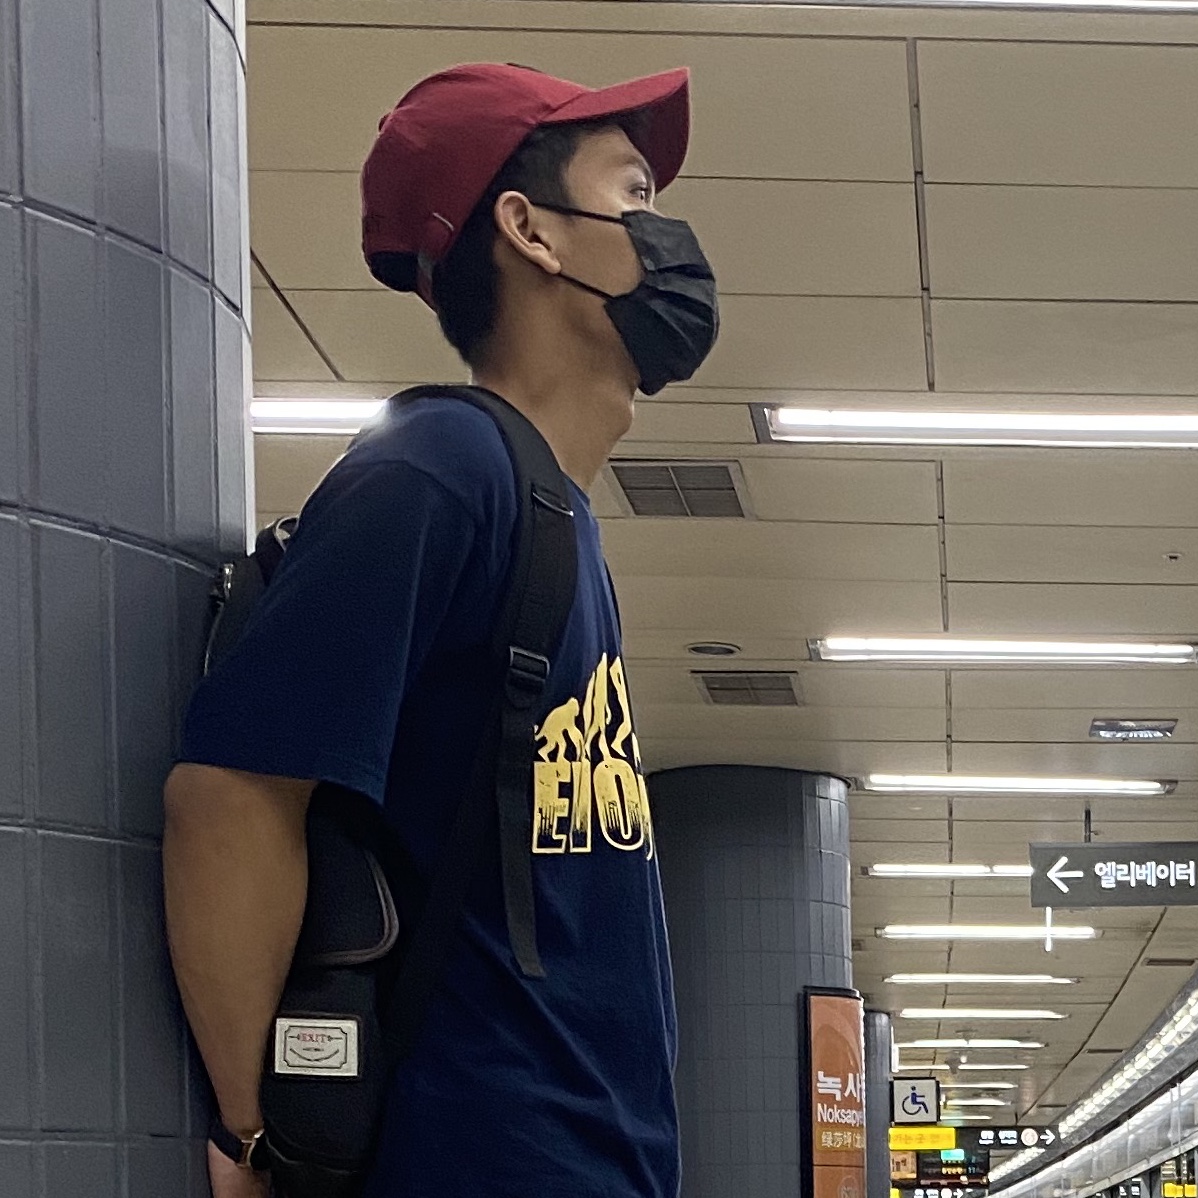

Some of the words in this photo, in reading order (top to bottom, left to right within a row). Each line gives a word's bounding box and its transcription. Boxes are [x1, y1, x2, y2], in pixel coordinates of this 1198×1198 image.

[1094, 860, 1196, 889] 엘리베이터
[301, 1032, 327, 1043] EXIT
[816, 1070, 864, 1104] 녹사
